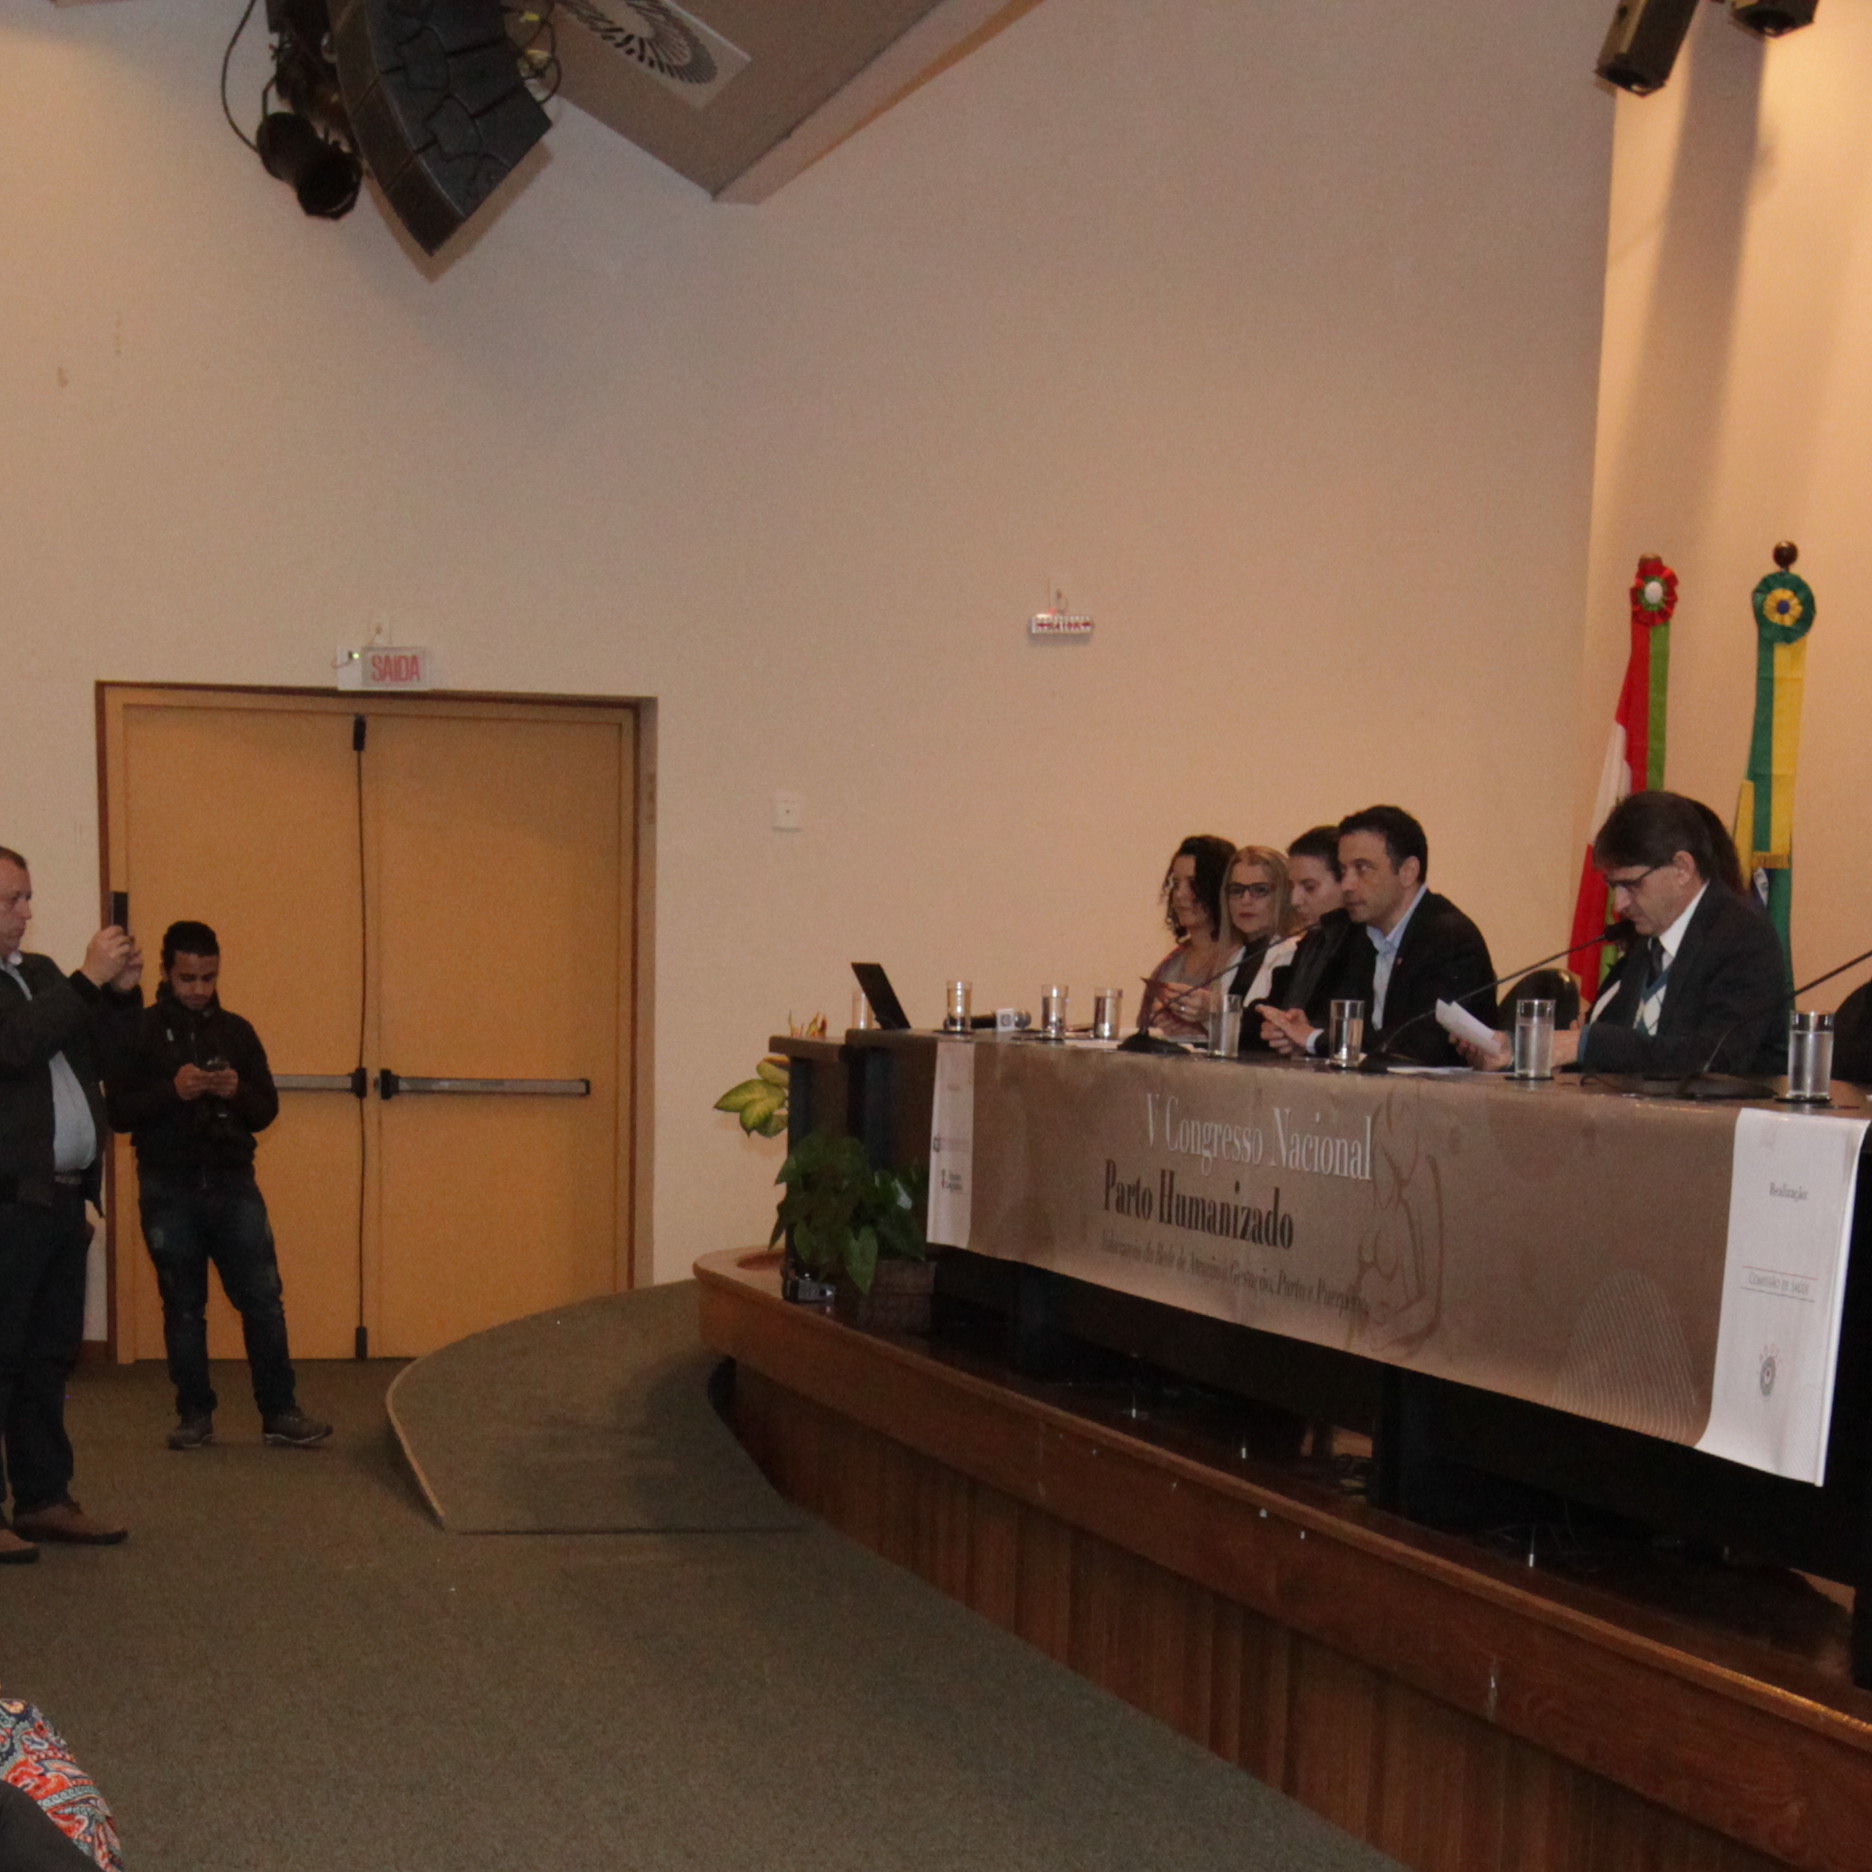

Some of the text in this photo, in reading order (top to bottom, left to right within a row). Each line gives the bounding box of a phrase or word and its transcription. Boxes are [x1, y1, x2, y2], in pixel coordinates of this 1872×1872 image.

[1146, 1093, 1372, 1181] V Congresso Nacional
[1103, 1158, 1154, 1222] Parto
[1158, 1168, 1294, 1251] Humanizado
[1277, 1269, 1307, 1299] Parto
